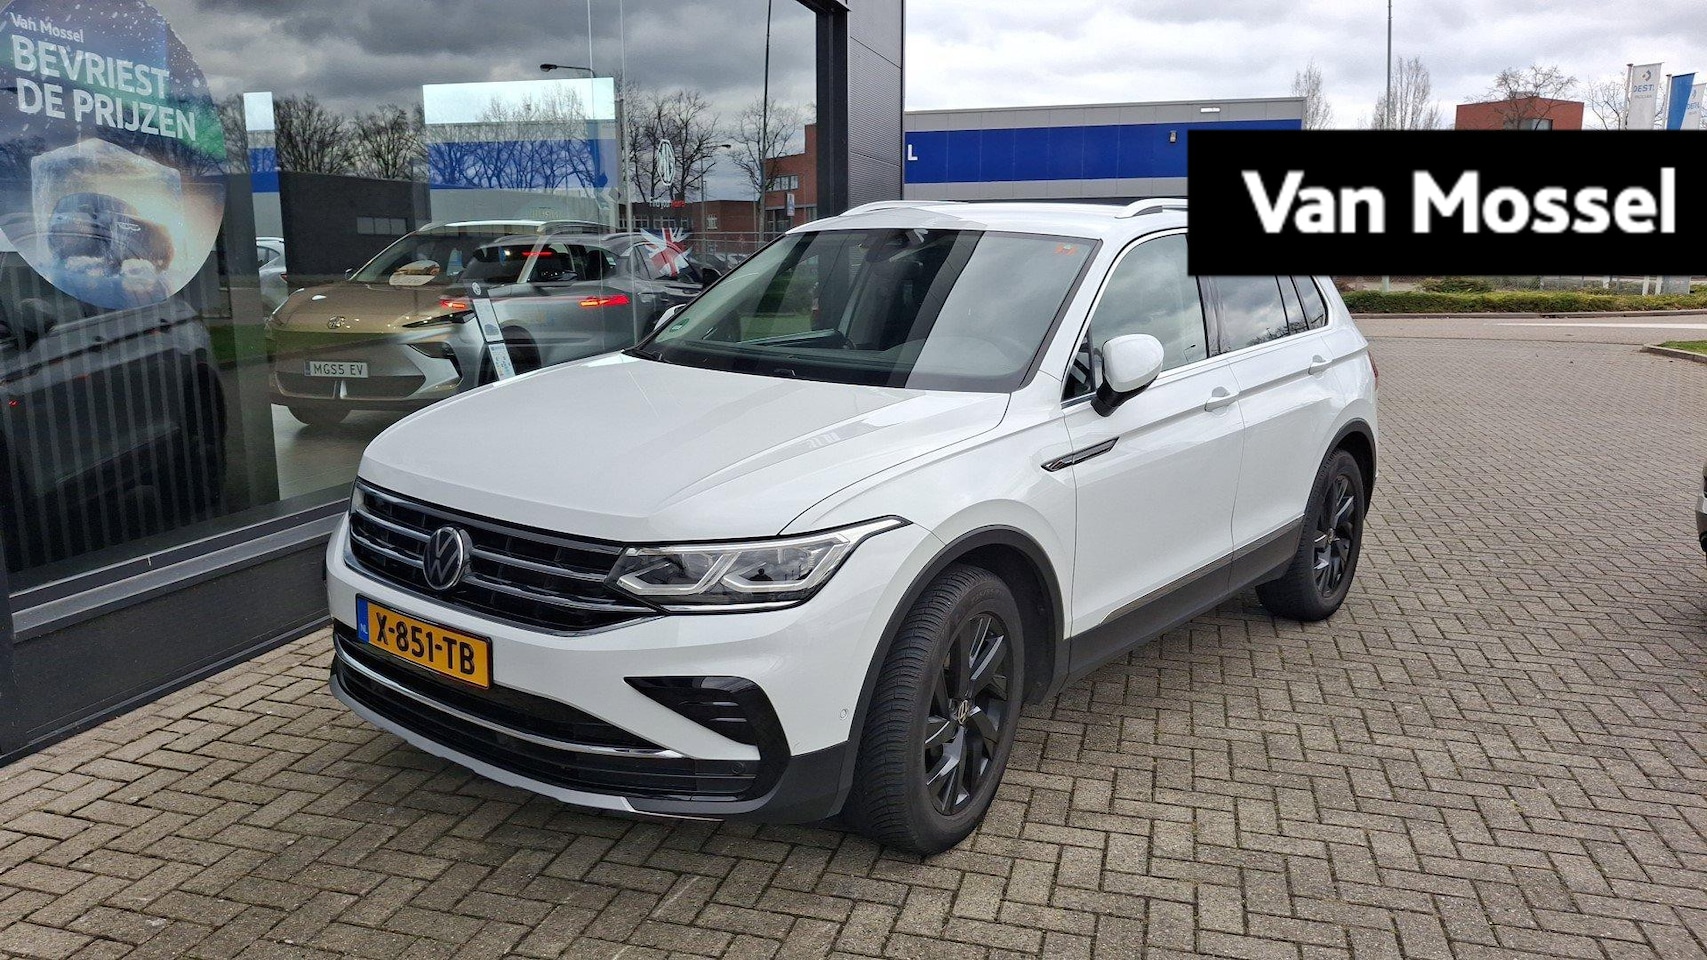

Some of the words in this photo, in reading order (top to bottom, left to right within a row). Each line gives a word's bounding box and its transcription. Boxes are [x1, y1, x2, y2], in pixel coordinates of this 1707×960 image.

[9, 12, 36, 31] Van
[40, 20, 84, 43] Mossel
[12, 34, 169, 99] BEVRIEST
[16, 78, 65, 119] DE
[73, 89, 197, 141] PRIJZEN
[313, 363, 345, 375] MGS5
[350, 364, 363, 376] EV
[376, 612, 475, 675] X-851-TB
